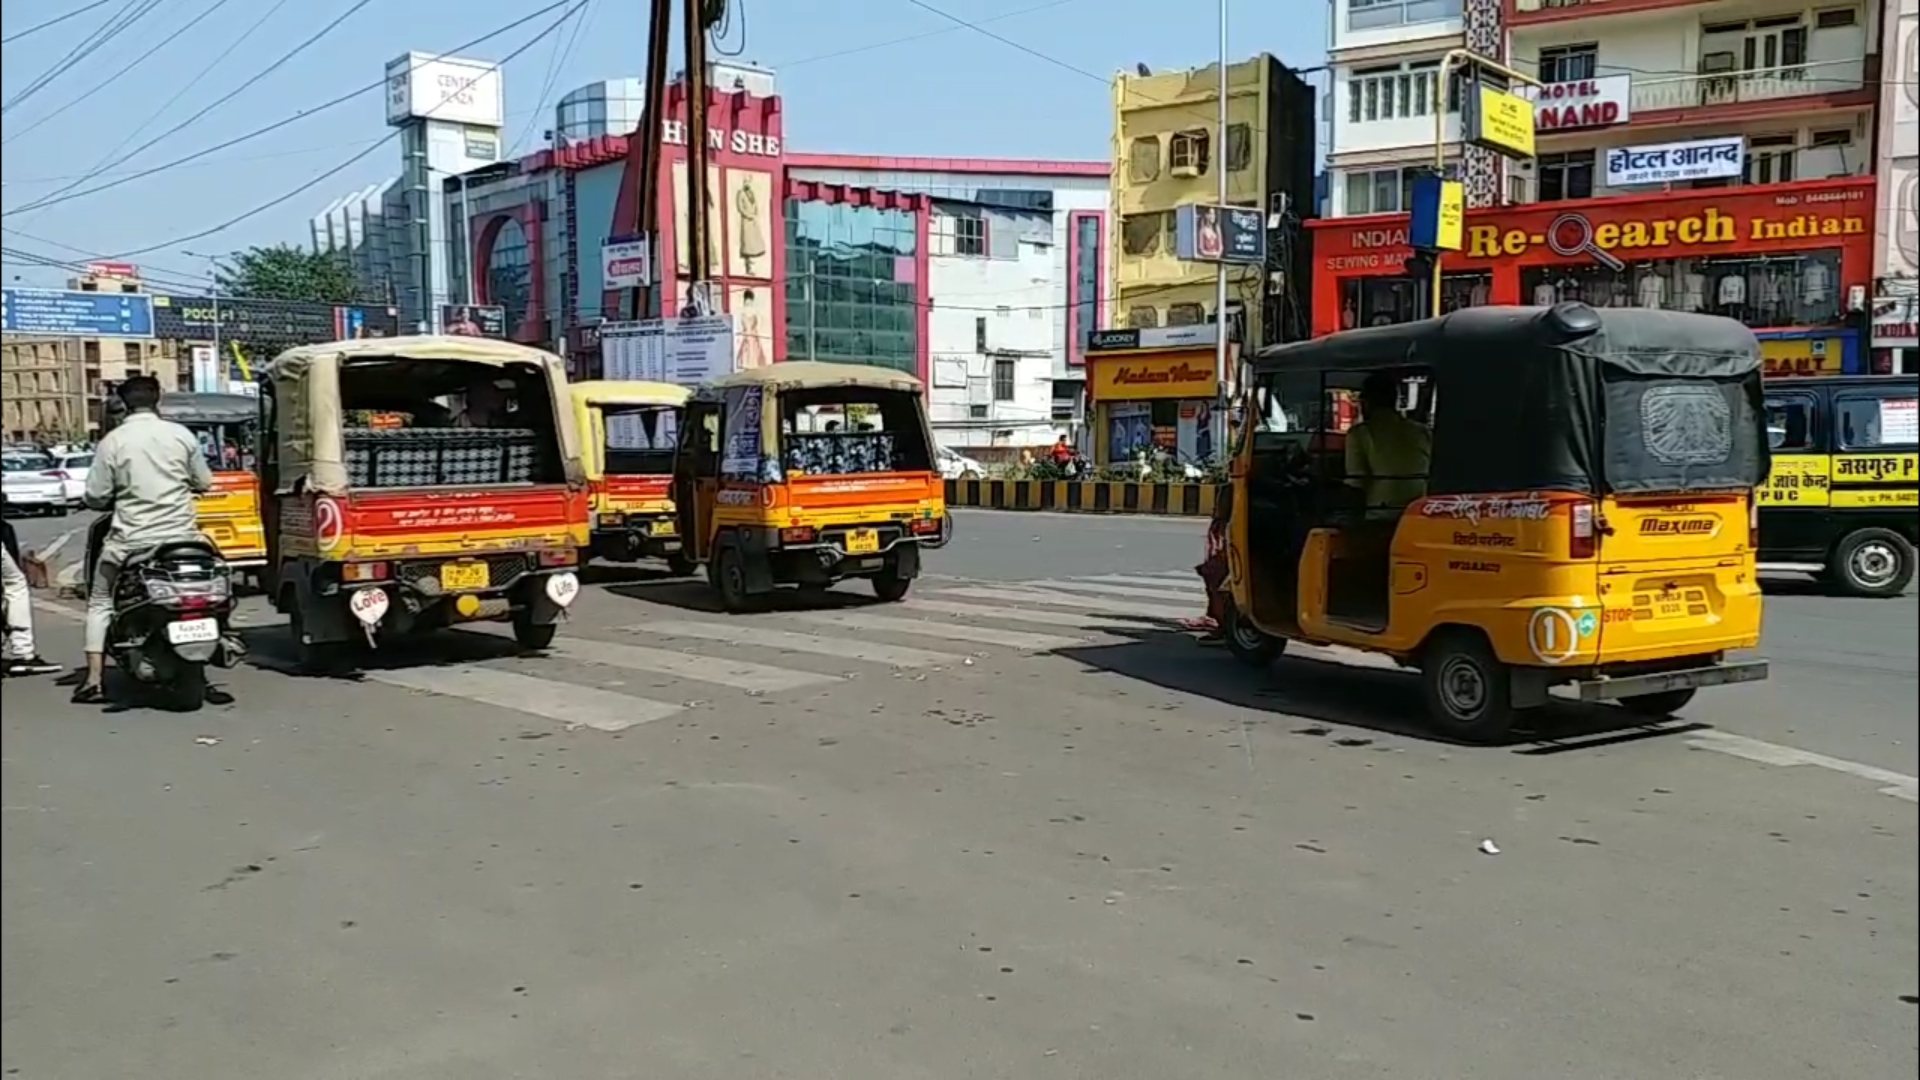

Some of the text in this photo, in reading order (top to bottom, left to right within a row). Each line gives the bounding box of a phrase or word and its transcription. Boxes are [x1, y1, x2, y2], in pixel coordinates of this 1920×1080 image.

[437, 74, 477, 91] CENTRE
[1540, 80, 1600, 99] HOTEL
[731, 129, 780, 156] SHE
[1609, 143, 1740, 173] होटल आनन्द
[1750, 214, 1866, 240] Indian
[1327, 256, 1379, 271] SEWING
[183, 307, 216, 320] POCO
[1113, 362, 1213, 385] Madam Wear
[1773, 471, 1799, 489] जांच
[1802, 470, 1828, 490] केन्द्र
[1640, 518, 1715, 534] Maxima
[1602, 608, 1632, 623] STOP
